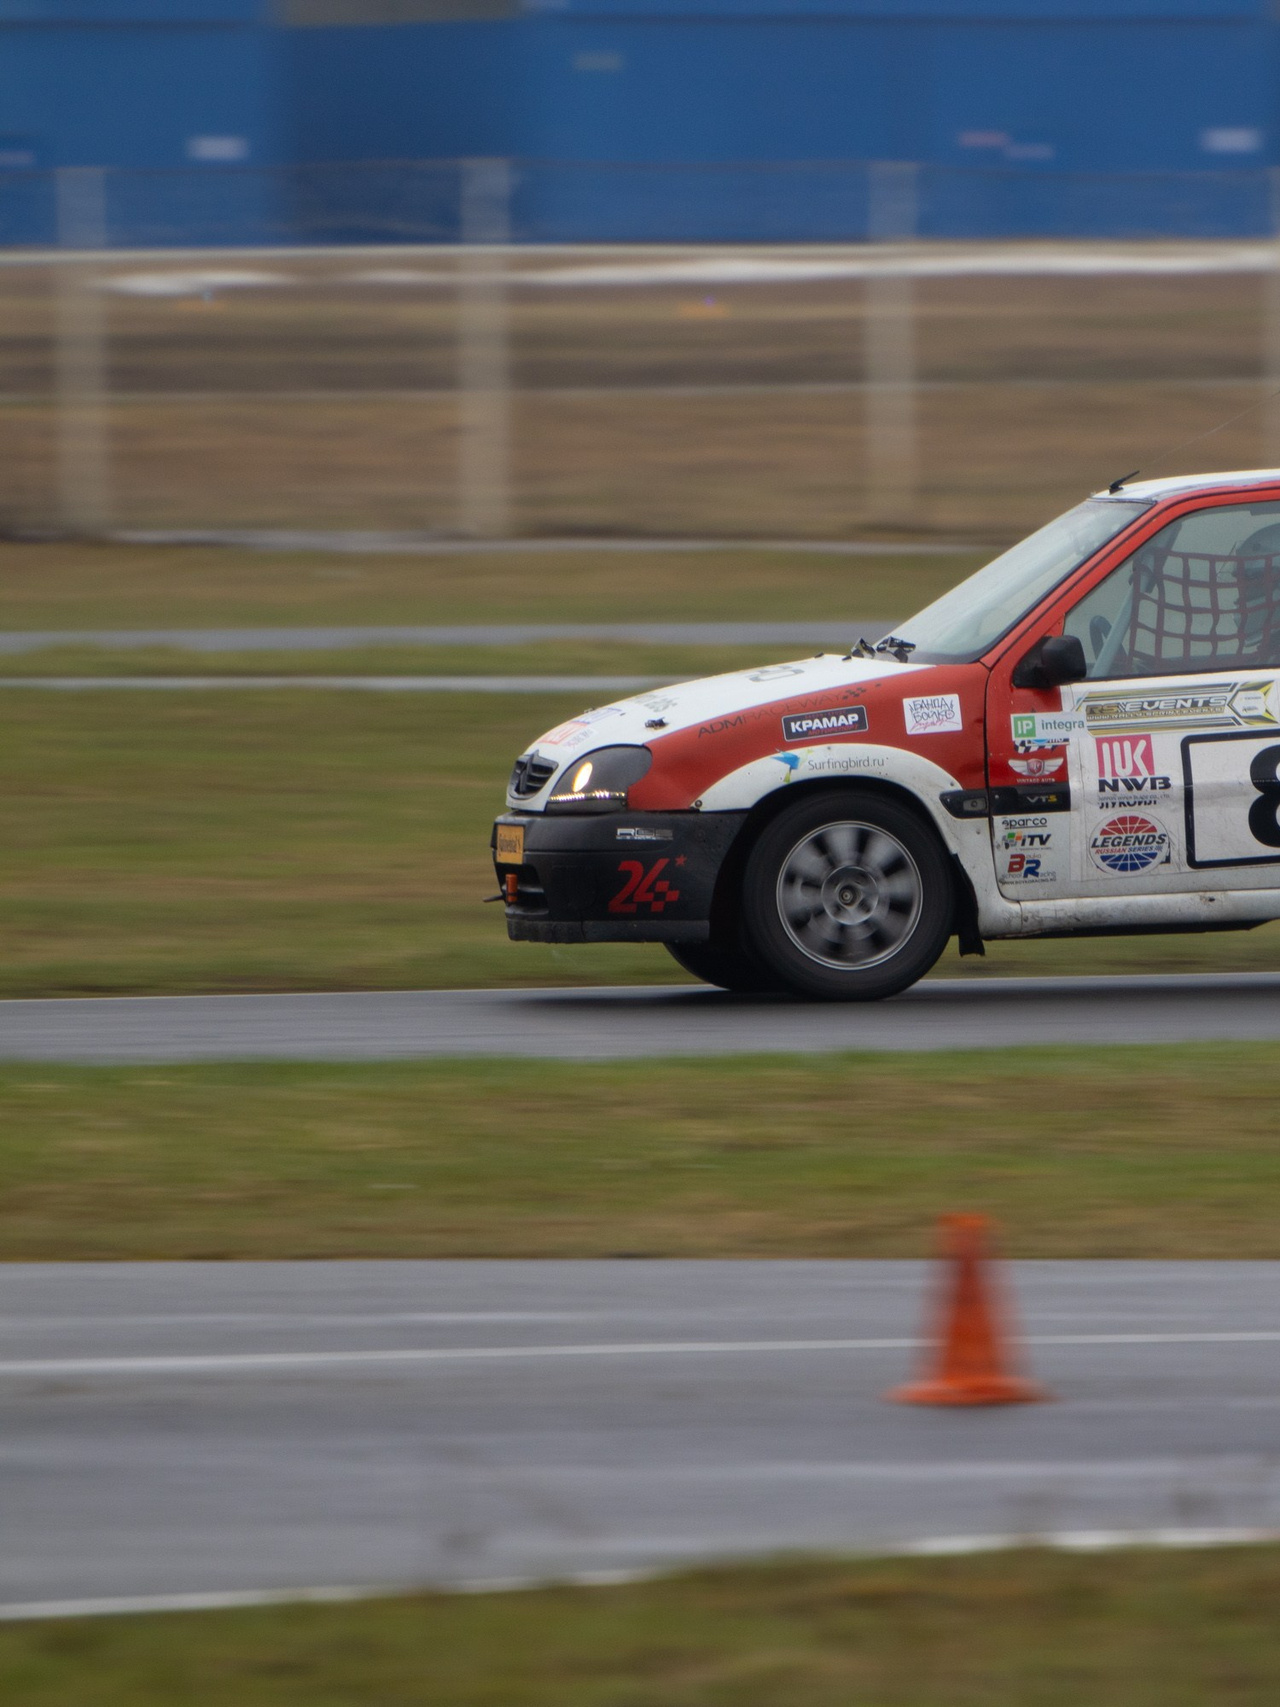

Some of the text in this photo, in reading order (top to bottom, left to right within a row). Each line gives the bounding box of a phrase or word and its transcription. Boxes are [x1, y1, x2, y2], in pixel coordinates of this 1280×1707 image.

[1125, 695, 1228, 712] EVENTS
[790, 713, 859, 733] КРАМАР
[1017, 720, 1085, 734] IP integra
[808, 757, 885, 772] Surfingbird.ru
[1098, 776, 1172, 793] NWB
[1026, 794, 1058, 803] VTS
[1002, 817, 1048, 829] sparco
[1090, 833, 1168, 849] LEGENDS
[1095, 847, 1127, 855] RUSSIAN
